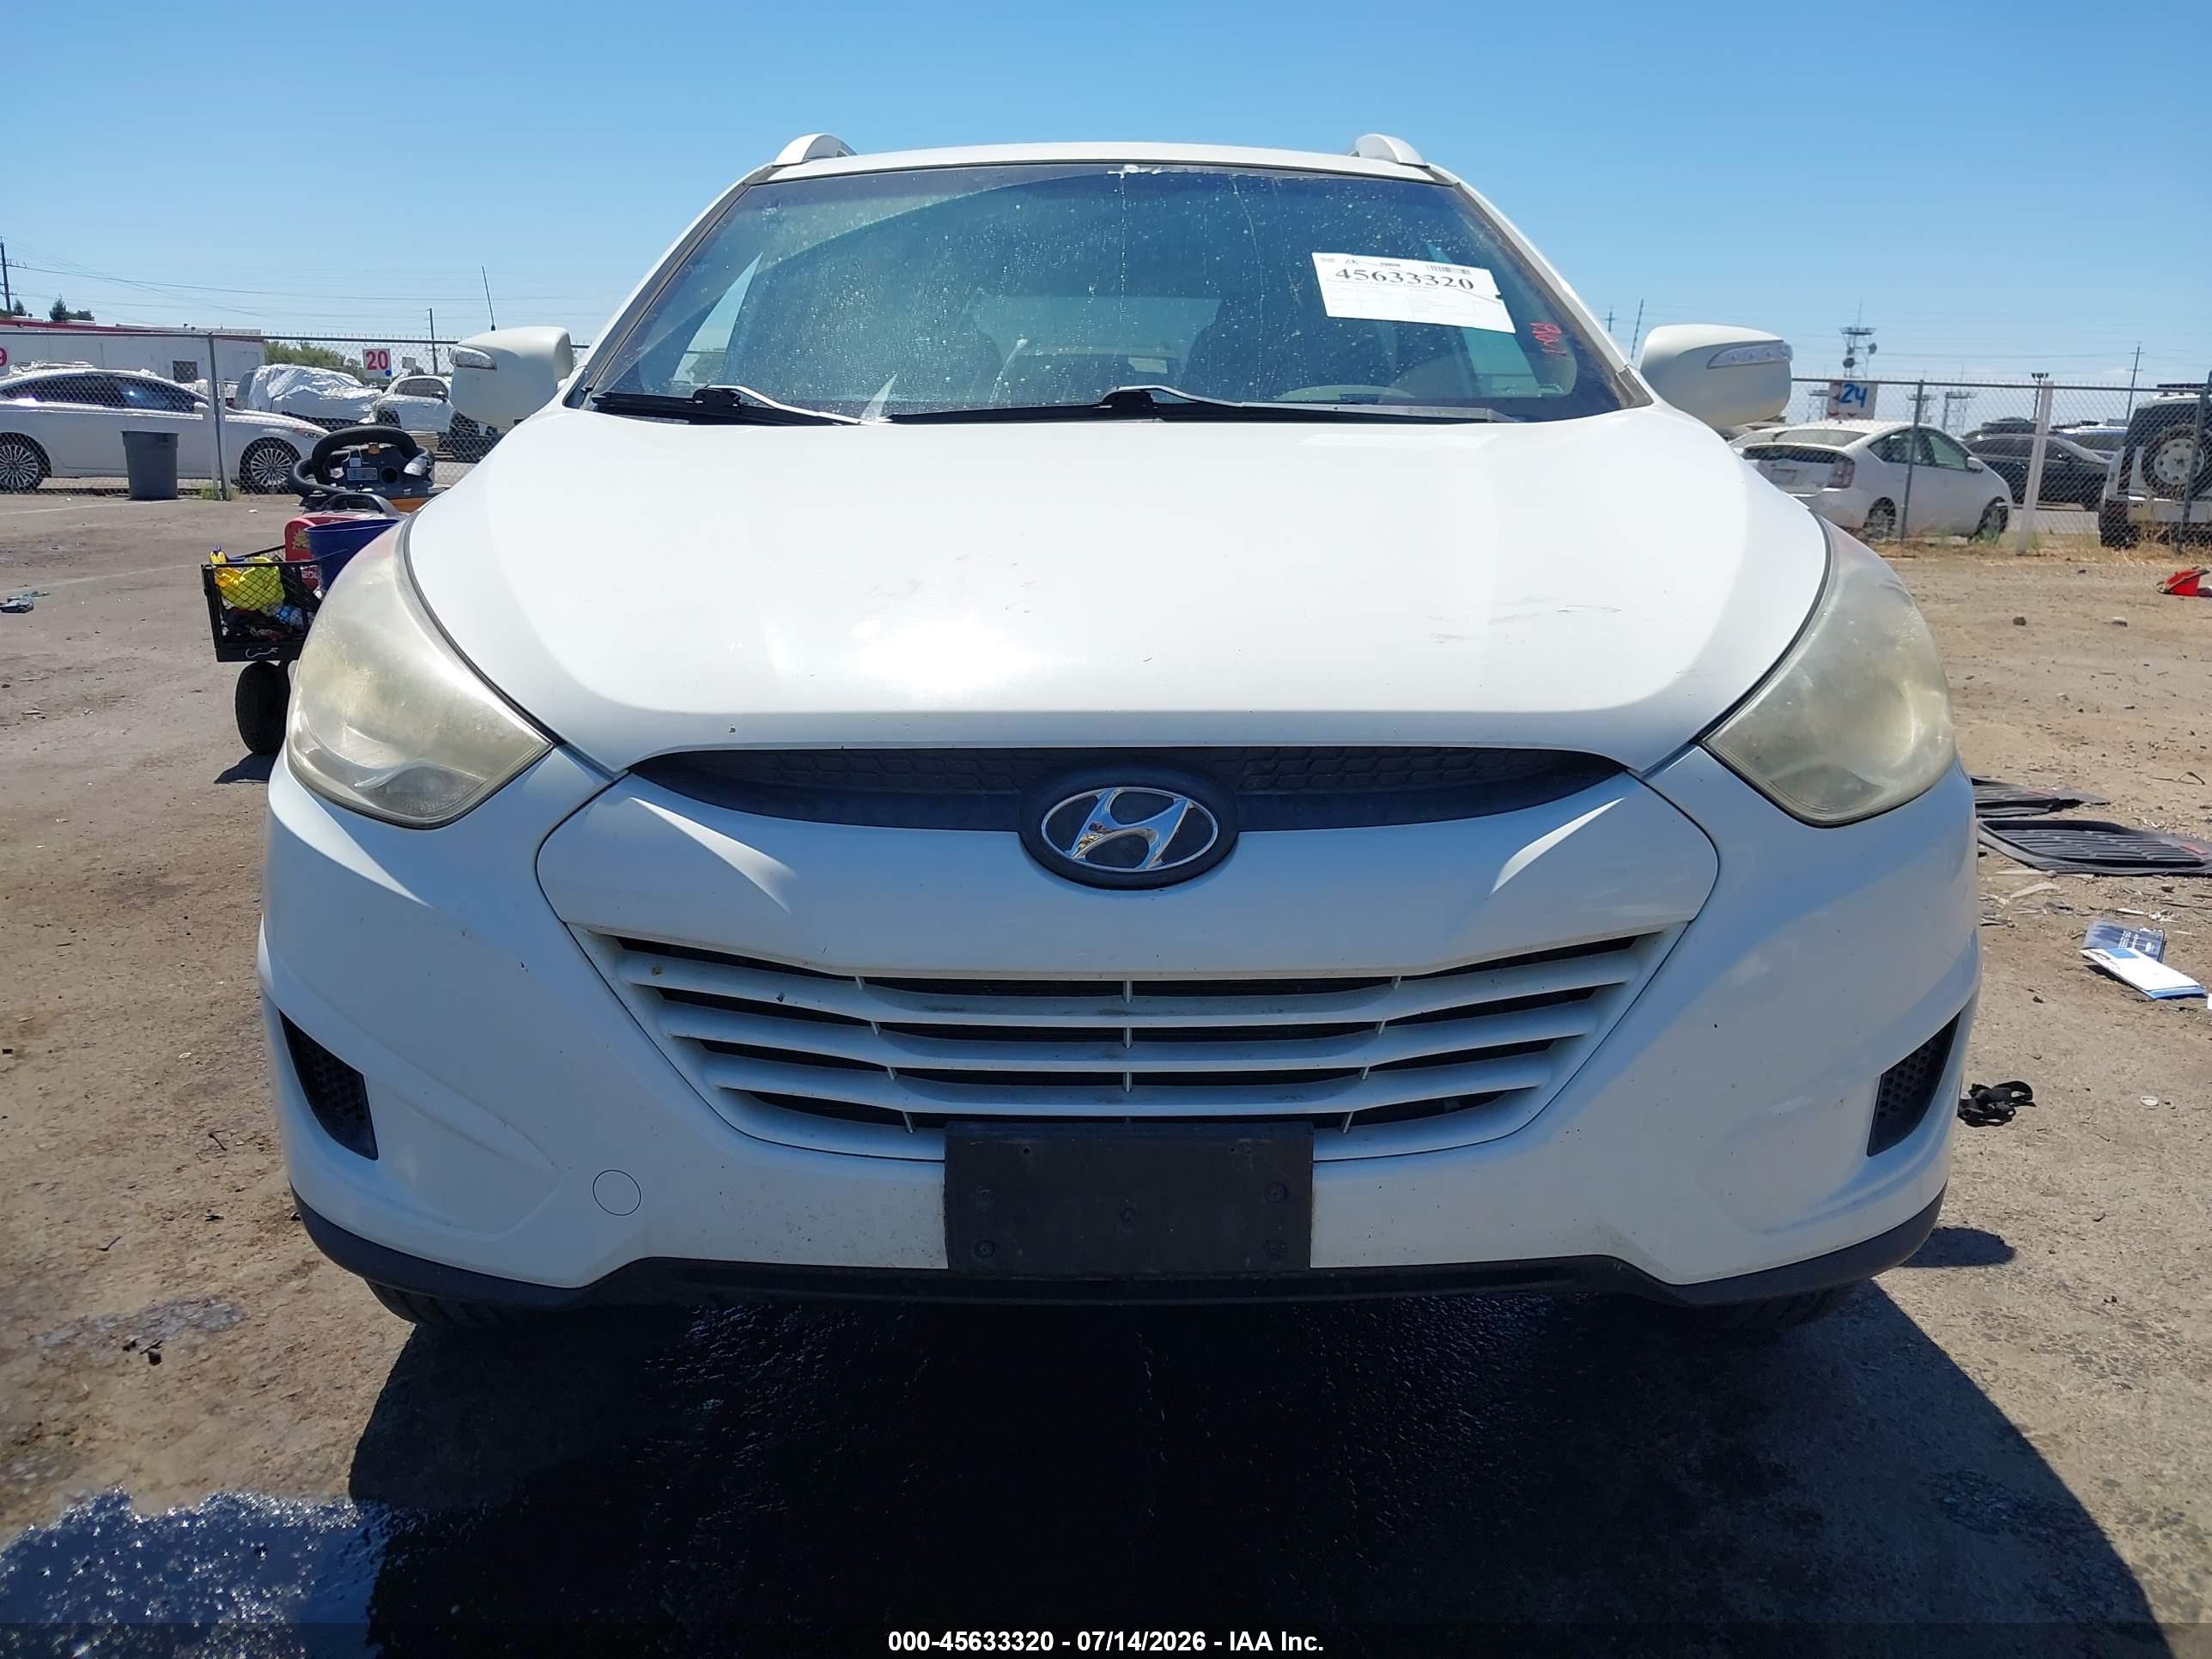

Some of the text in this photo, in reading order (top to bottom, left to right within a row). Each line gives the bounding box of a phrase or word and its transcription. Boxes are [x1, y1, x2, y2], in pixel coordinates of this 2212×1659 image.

[1335, 268, 1474, 290] 45633320
[366, 350, 389, 370] 20
[1840, 383, 1868, 408] 24
